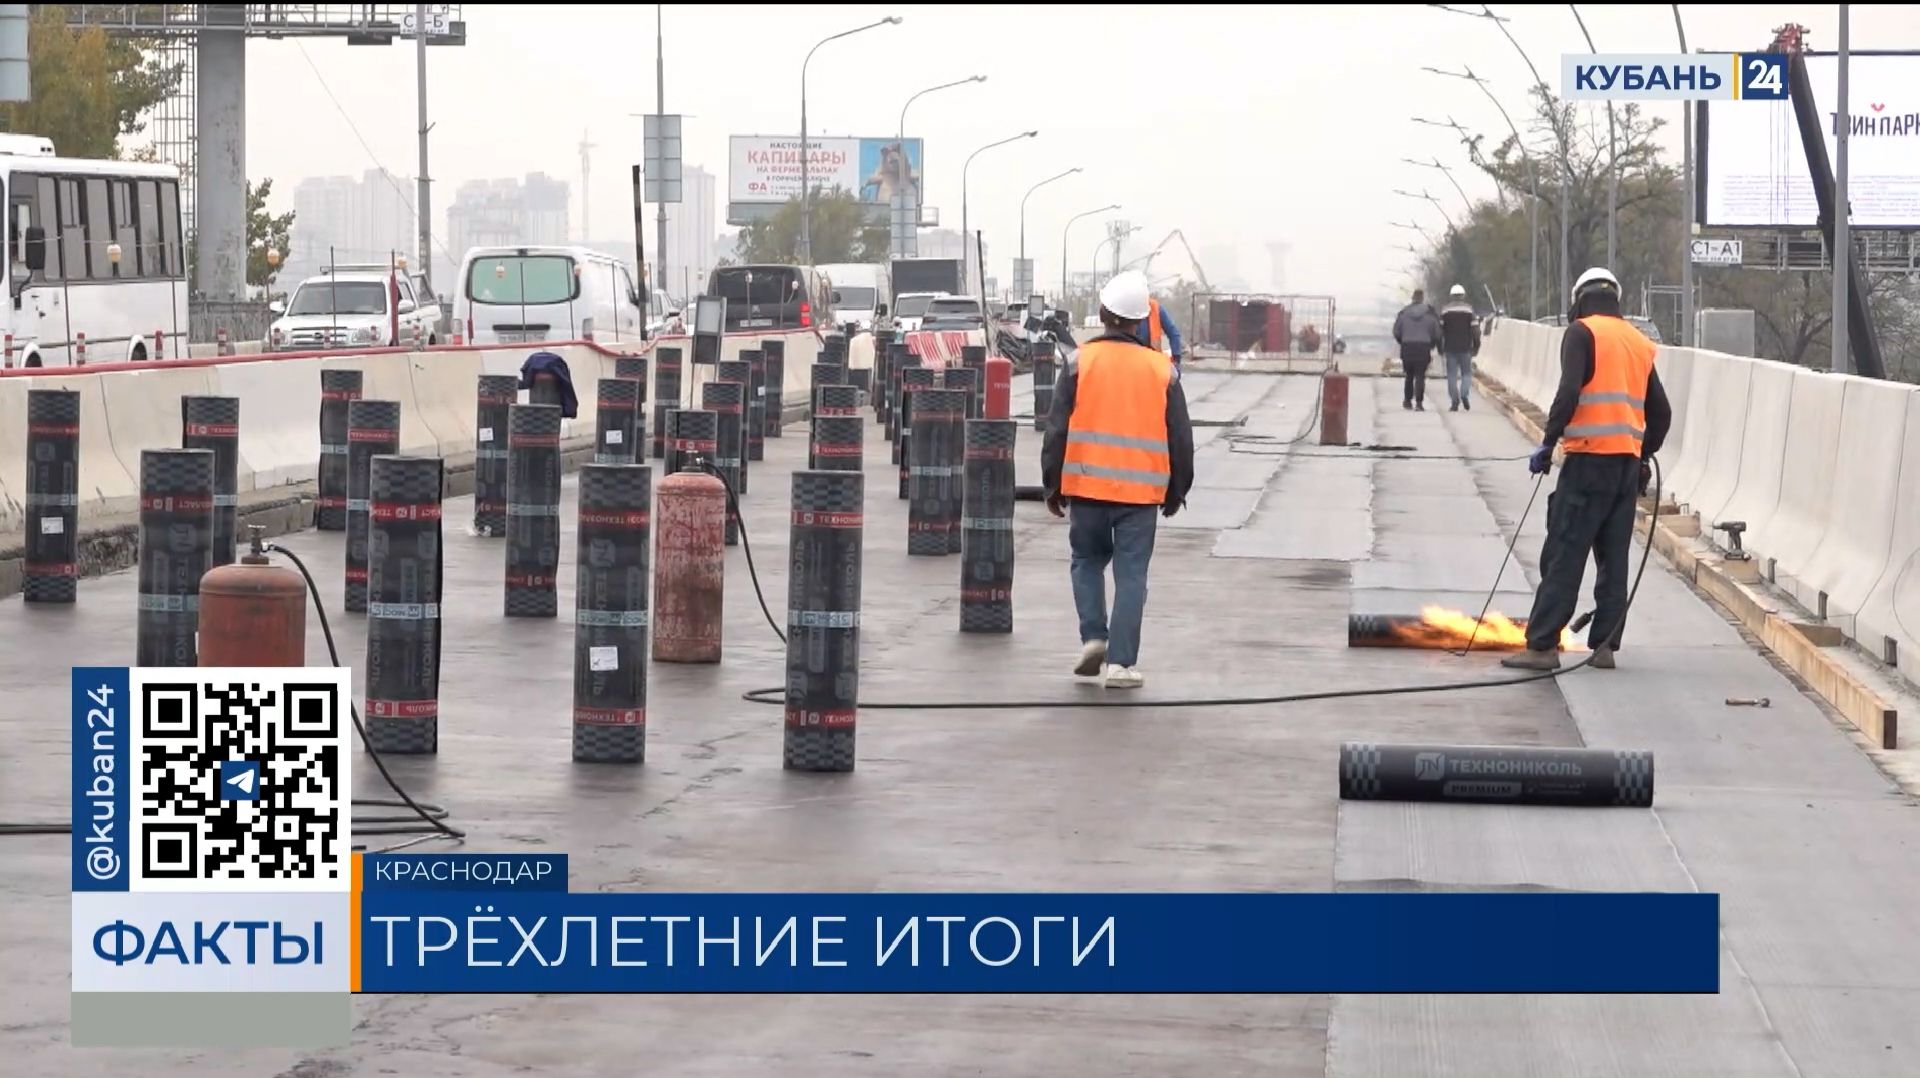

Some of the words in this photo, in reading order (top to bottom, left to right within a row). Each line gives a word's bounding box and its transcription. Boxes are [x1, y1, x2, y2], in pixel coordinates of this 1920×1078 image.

[403, 14, 444, 28] С-Б
[748, 182, 767, 191] ФА
[1449, 758, 1583, 776] ТЕХНОНИКОЛЬ
